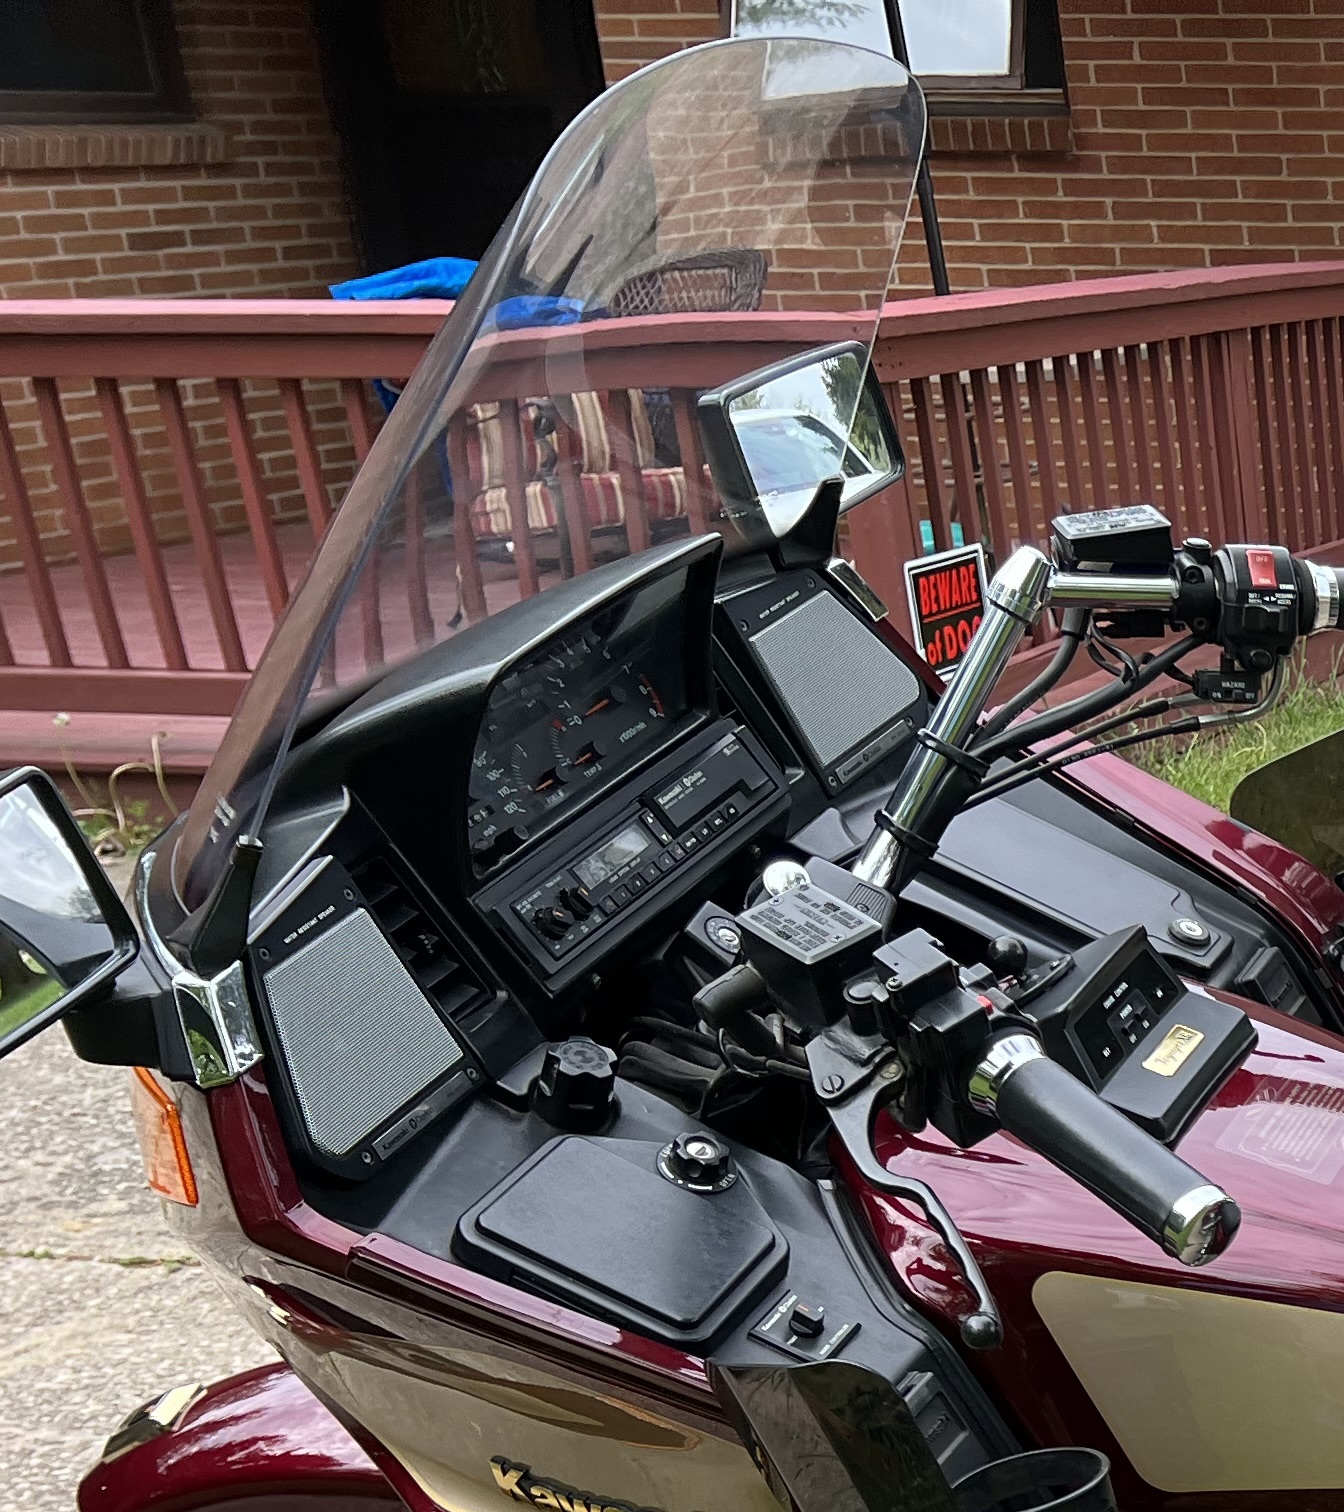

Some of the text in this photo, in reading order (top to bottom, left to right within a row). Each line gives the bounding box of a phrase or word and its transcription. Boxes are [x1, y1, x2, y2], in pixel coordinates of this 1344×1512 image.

[919, 564, 978, 616] BEWARE
[926, 630, 943, 666] of
[498, 785, 511, 798] 110
[504, 802, 518, 815] 120
